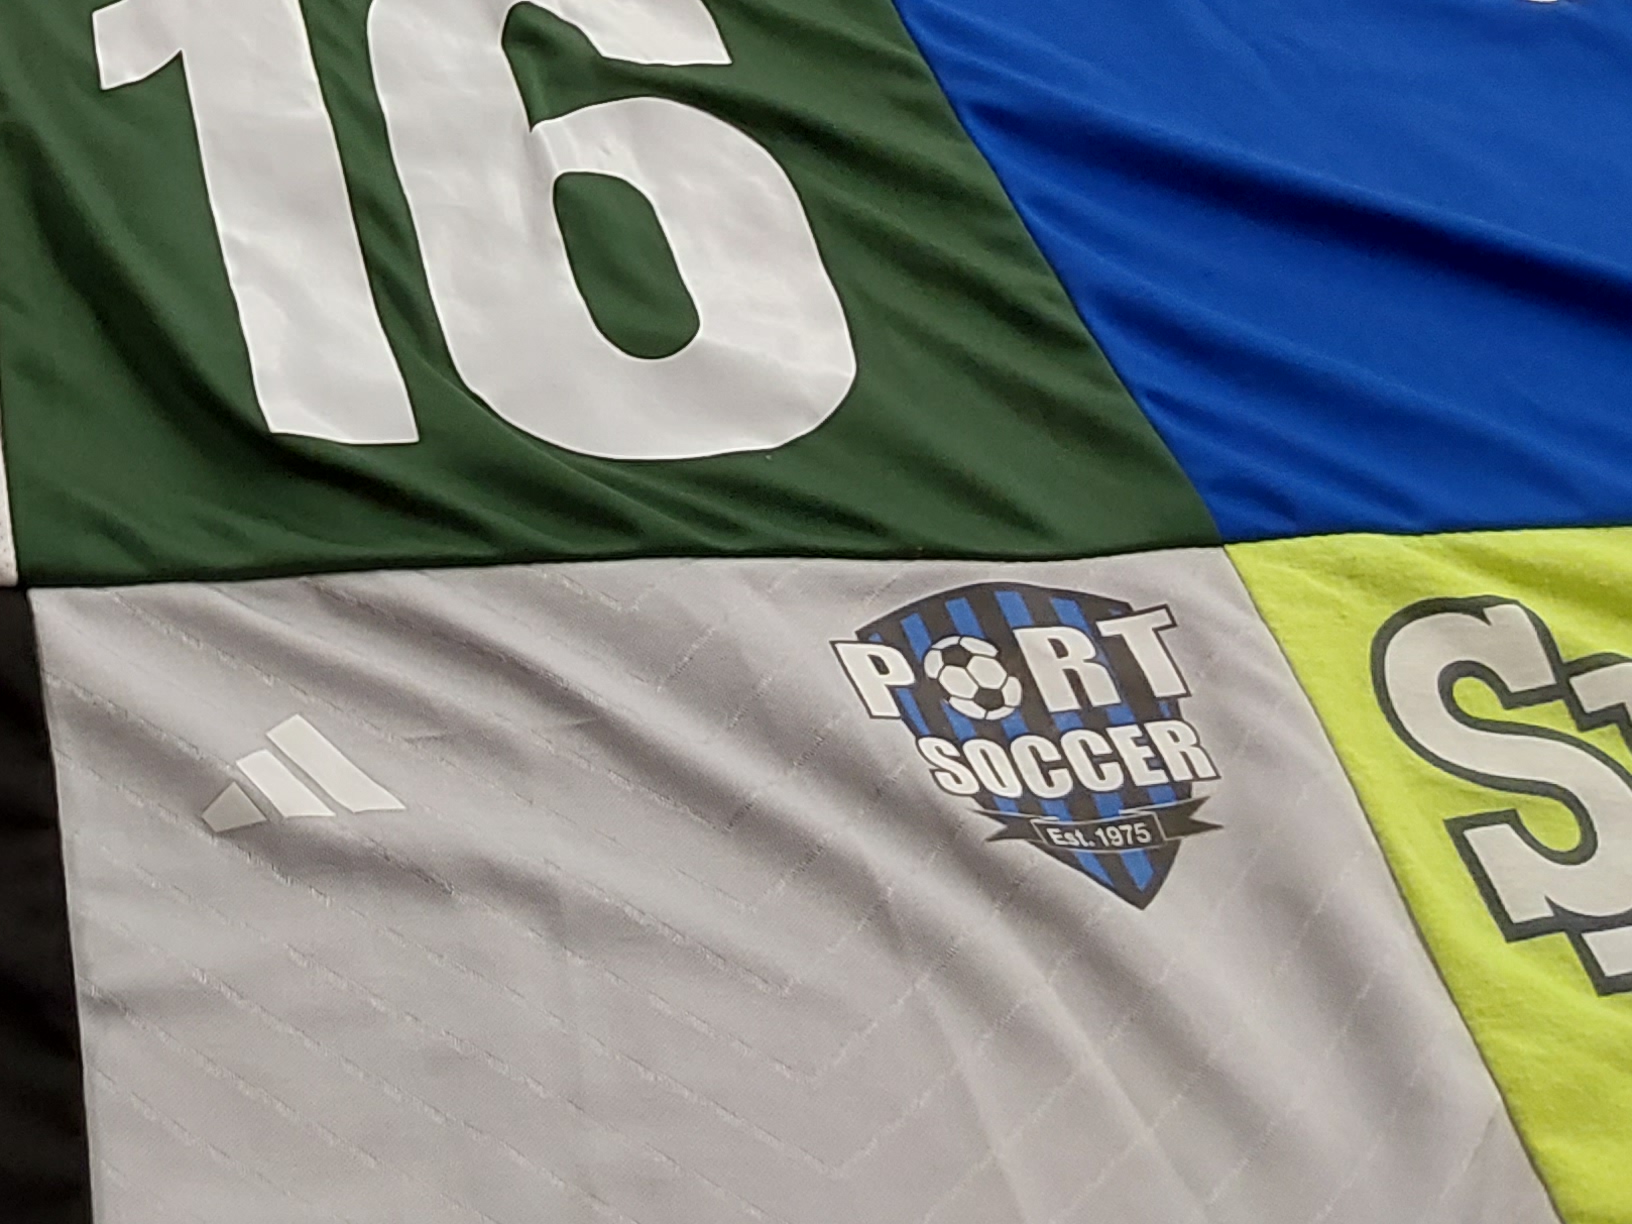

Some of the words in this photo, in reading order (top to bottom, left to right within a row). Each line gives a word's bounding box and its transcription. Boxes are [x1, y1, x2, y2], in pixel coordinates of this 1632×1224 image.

[830, 604, 1193, 721] PORT
[918, 717, 1222, 799] SOCCER
[1047, 828, 1095, 848] Est.
[1095, 822, 1151, 848] 1975
